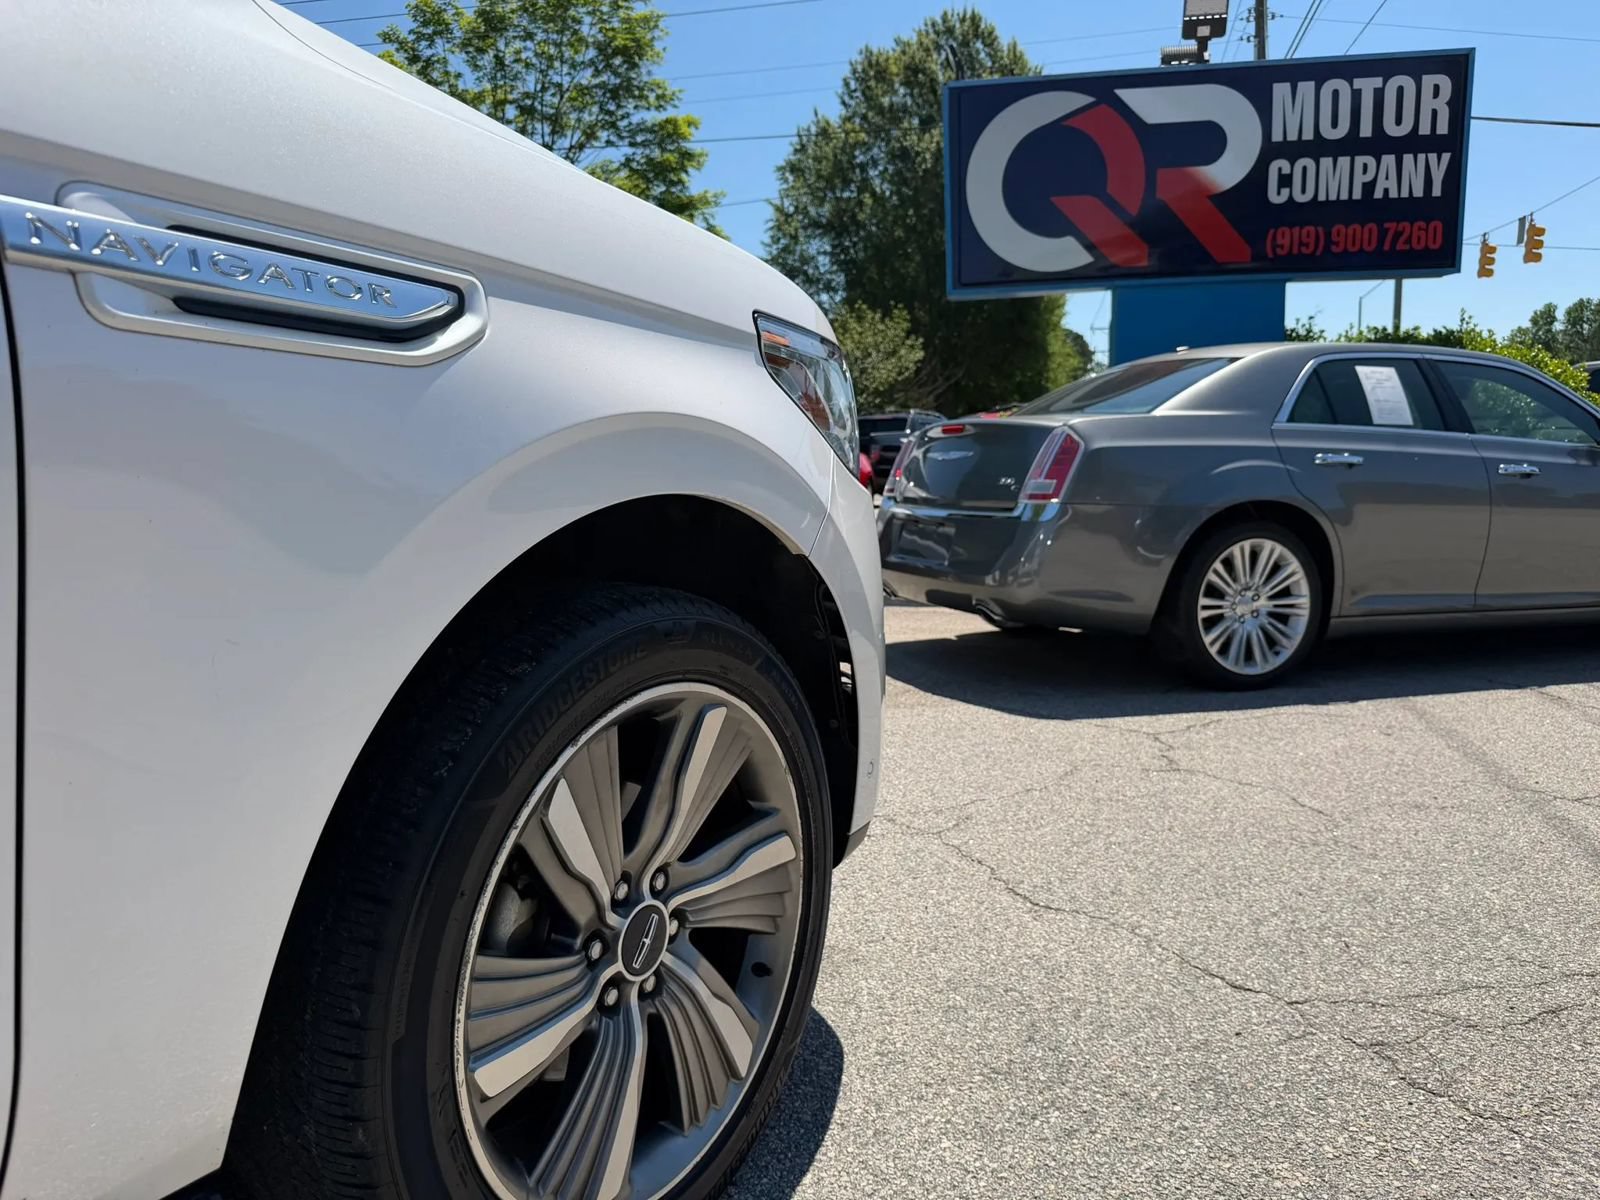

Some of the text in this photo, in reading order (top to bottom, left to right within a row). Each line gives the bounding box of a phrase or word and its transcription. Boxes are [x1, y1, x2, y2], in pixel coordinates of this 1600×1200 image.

[1271, 74, 1452, 142] MOTOR
[966, 84, 1262, 272] QR
[1267, 152, 1452, 204] COMPANY
[25, 211, 398, 308] NAVIGATOR
[1265, 220, 1443, 258] (919) 900 7260
